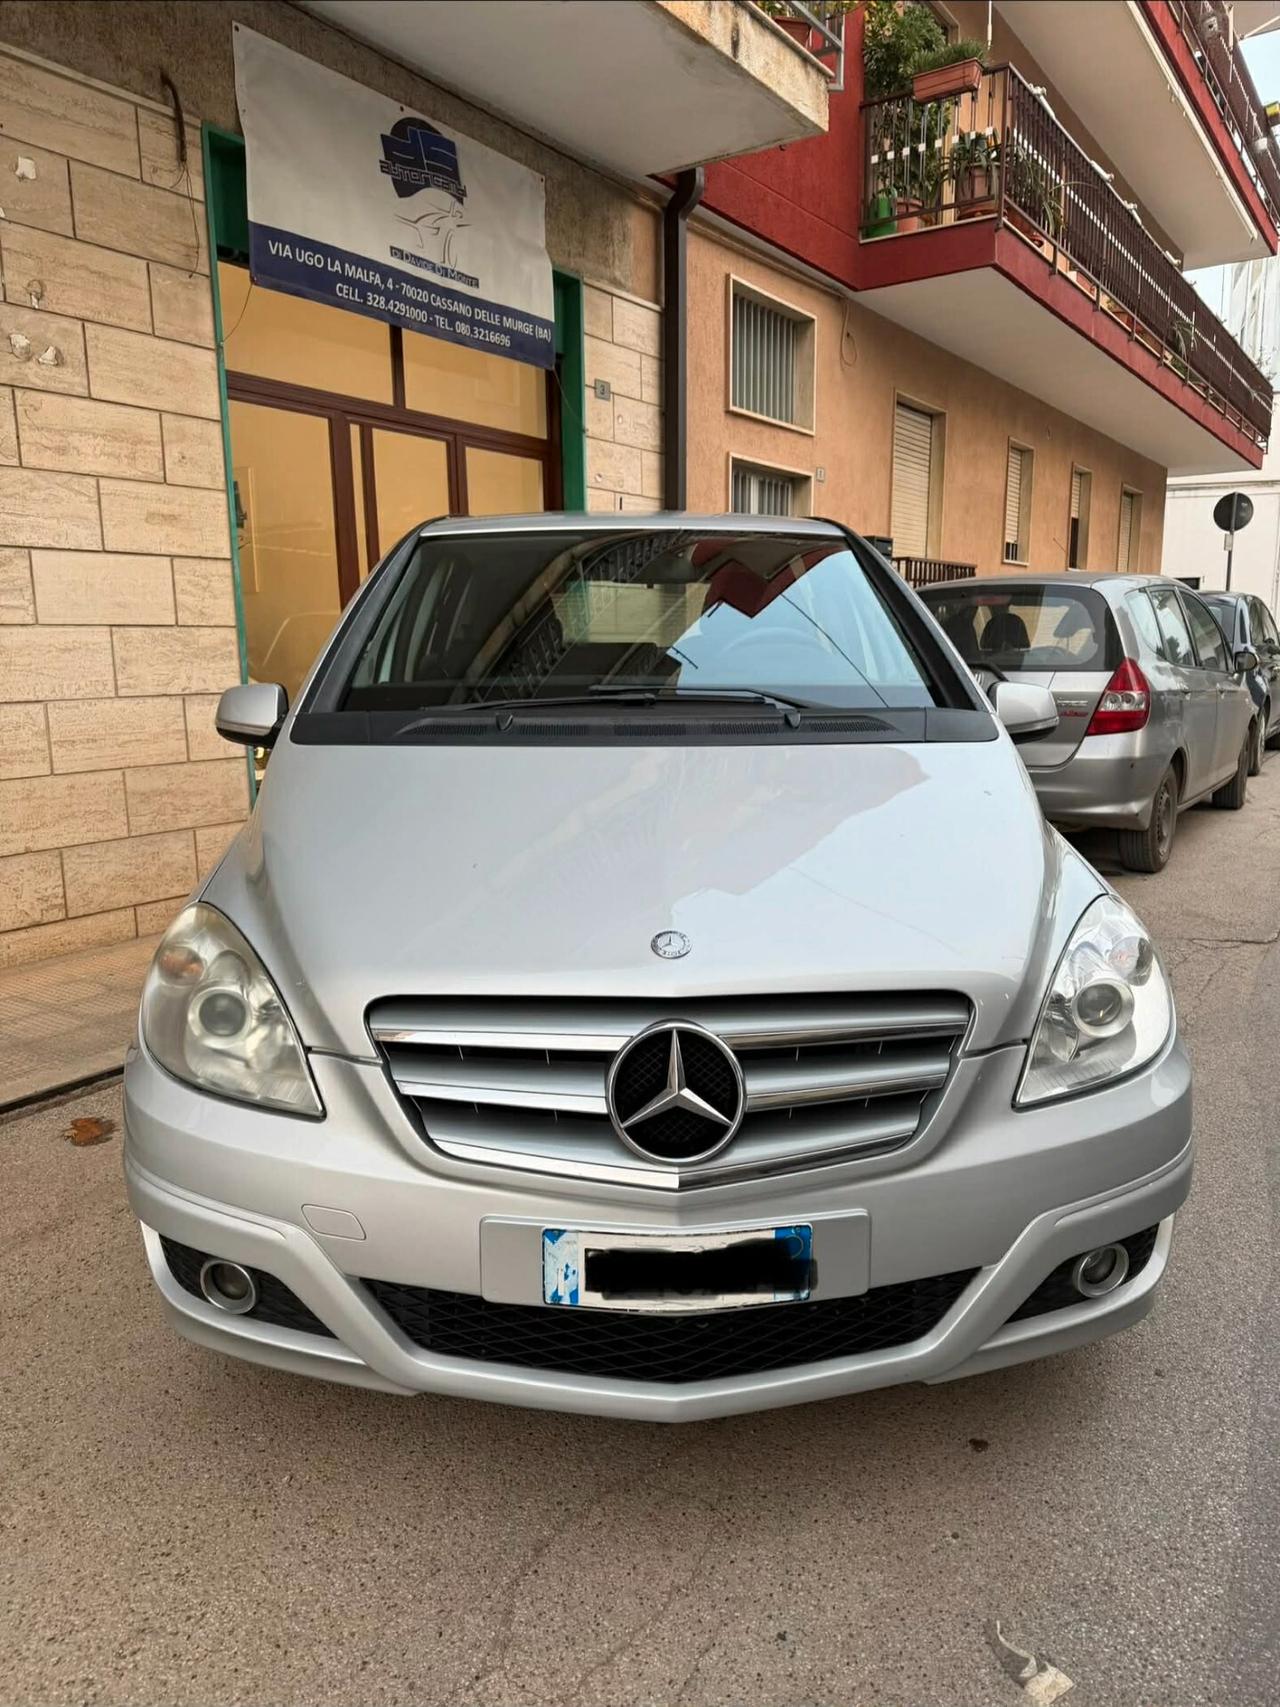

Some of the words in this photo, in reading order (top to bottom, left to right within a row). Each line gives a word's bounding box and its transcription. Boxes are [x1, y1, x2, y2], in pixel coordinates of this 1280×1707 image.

[268, 239, 293, 260] VIA
[295, 247, 324, 269] UGO
[327, 256, 342, 274] LA
[344, 263, 385, 291] MALFA,
[386, 277, 394, 291] 4
[401, 282, 429, 303] 70020
[430, 293, 472, 317] CASSANO
[474, 307, 501, 326] DELLE
[502, 315, 534, 336] MURGE
[535, 324, 552, 343] (BA)
[335, 282, 363, 303] CELL.
[366, 291, 428, 323] 328.4291000
[434, 314, 453, 331] TEL.
[455, 320, 511, 348] 080.3216696
